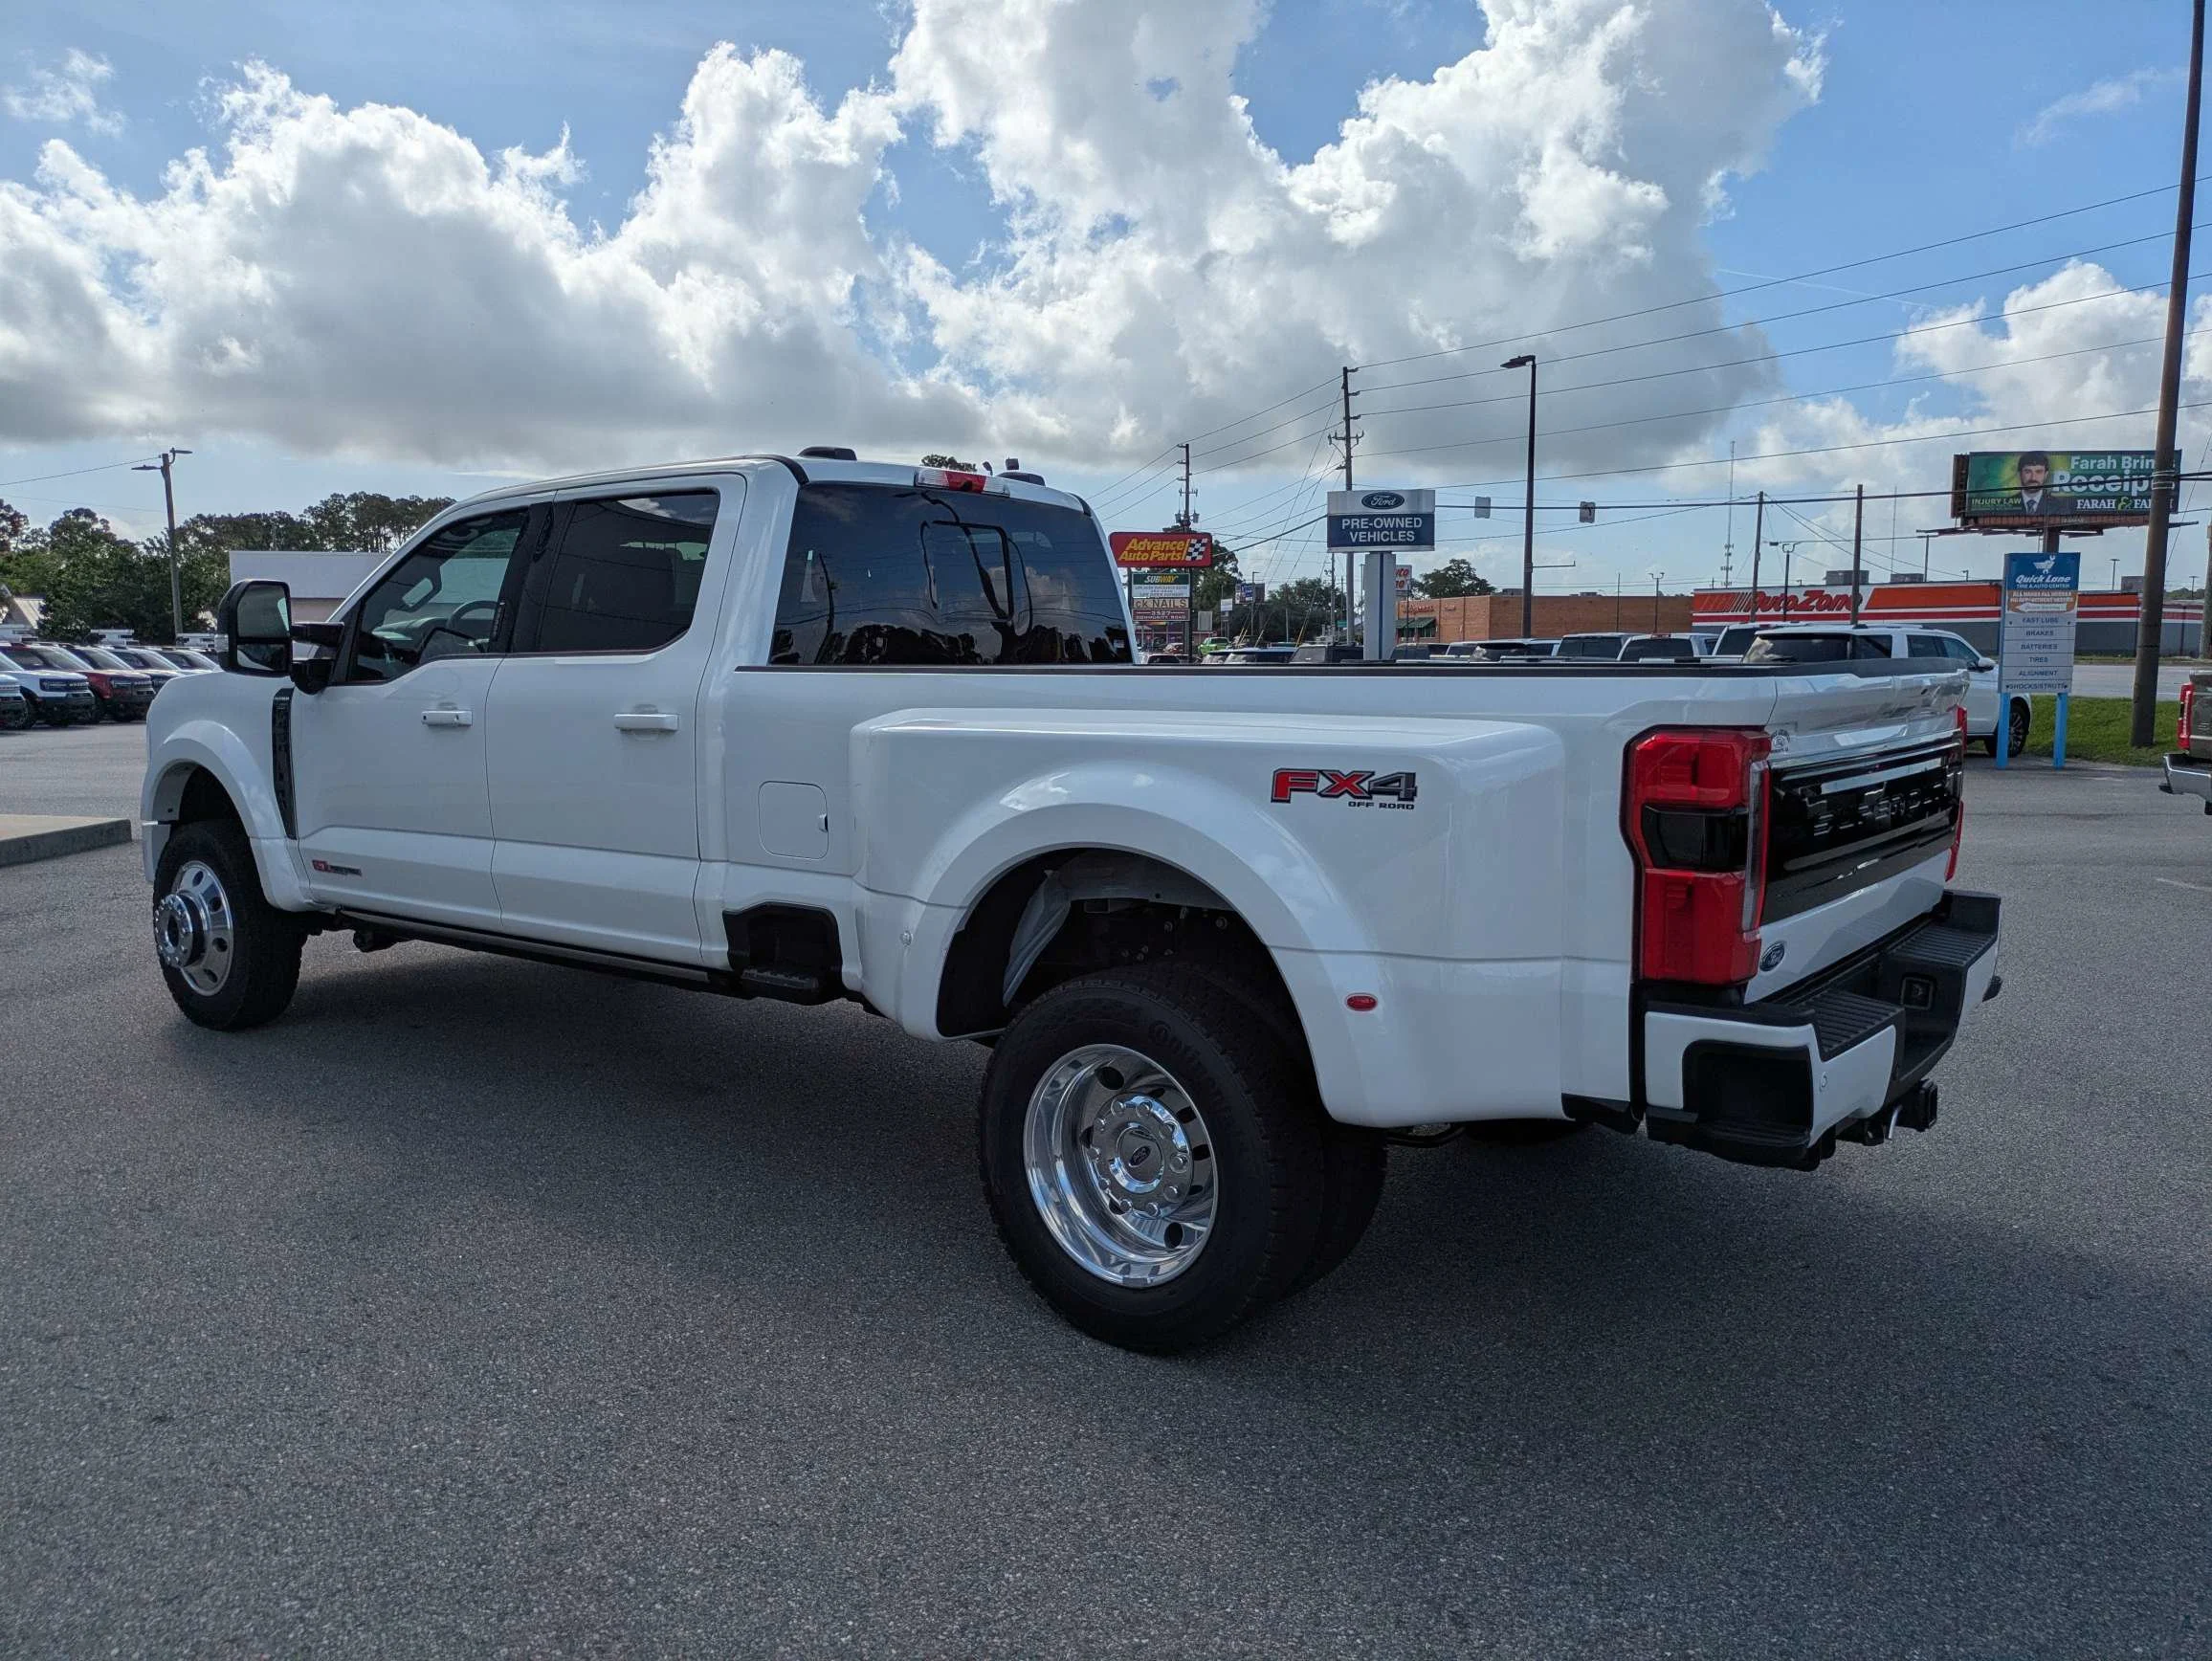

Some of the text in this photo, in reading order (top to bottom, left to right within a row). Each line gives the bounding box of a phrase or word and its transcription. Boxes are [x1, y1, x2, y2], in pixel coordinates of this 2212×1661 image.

[2070, 454, 2157, 470] Farah Brin
[2052, 468, 2151, 497] Receip
[1370, 495, 1397, 506] Ford
[1972, 497, 2022, 506] INJURY LAW
[2076, 498, 2116, 509] FARAH
[2117, 497, 2134, 511] &
[1341, 517, 1423, 530] PRE-OWNED
[1349, 530, 1415, 543] VEHICLES
[1125, 538, 1185, 551] Advance
[1118, 550, 1183, 562] Auto Parts
[1143, 575, 1178, 584] SUBWAY
[2015, 574, 2071, 584] Quick Lane
[1152, 599, 1187, 608] NAILS
[1271, 767, 1418, 804] FX4
[1379, 802, 1415, 810] ROAD
